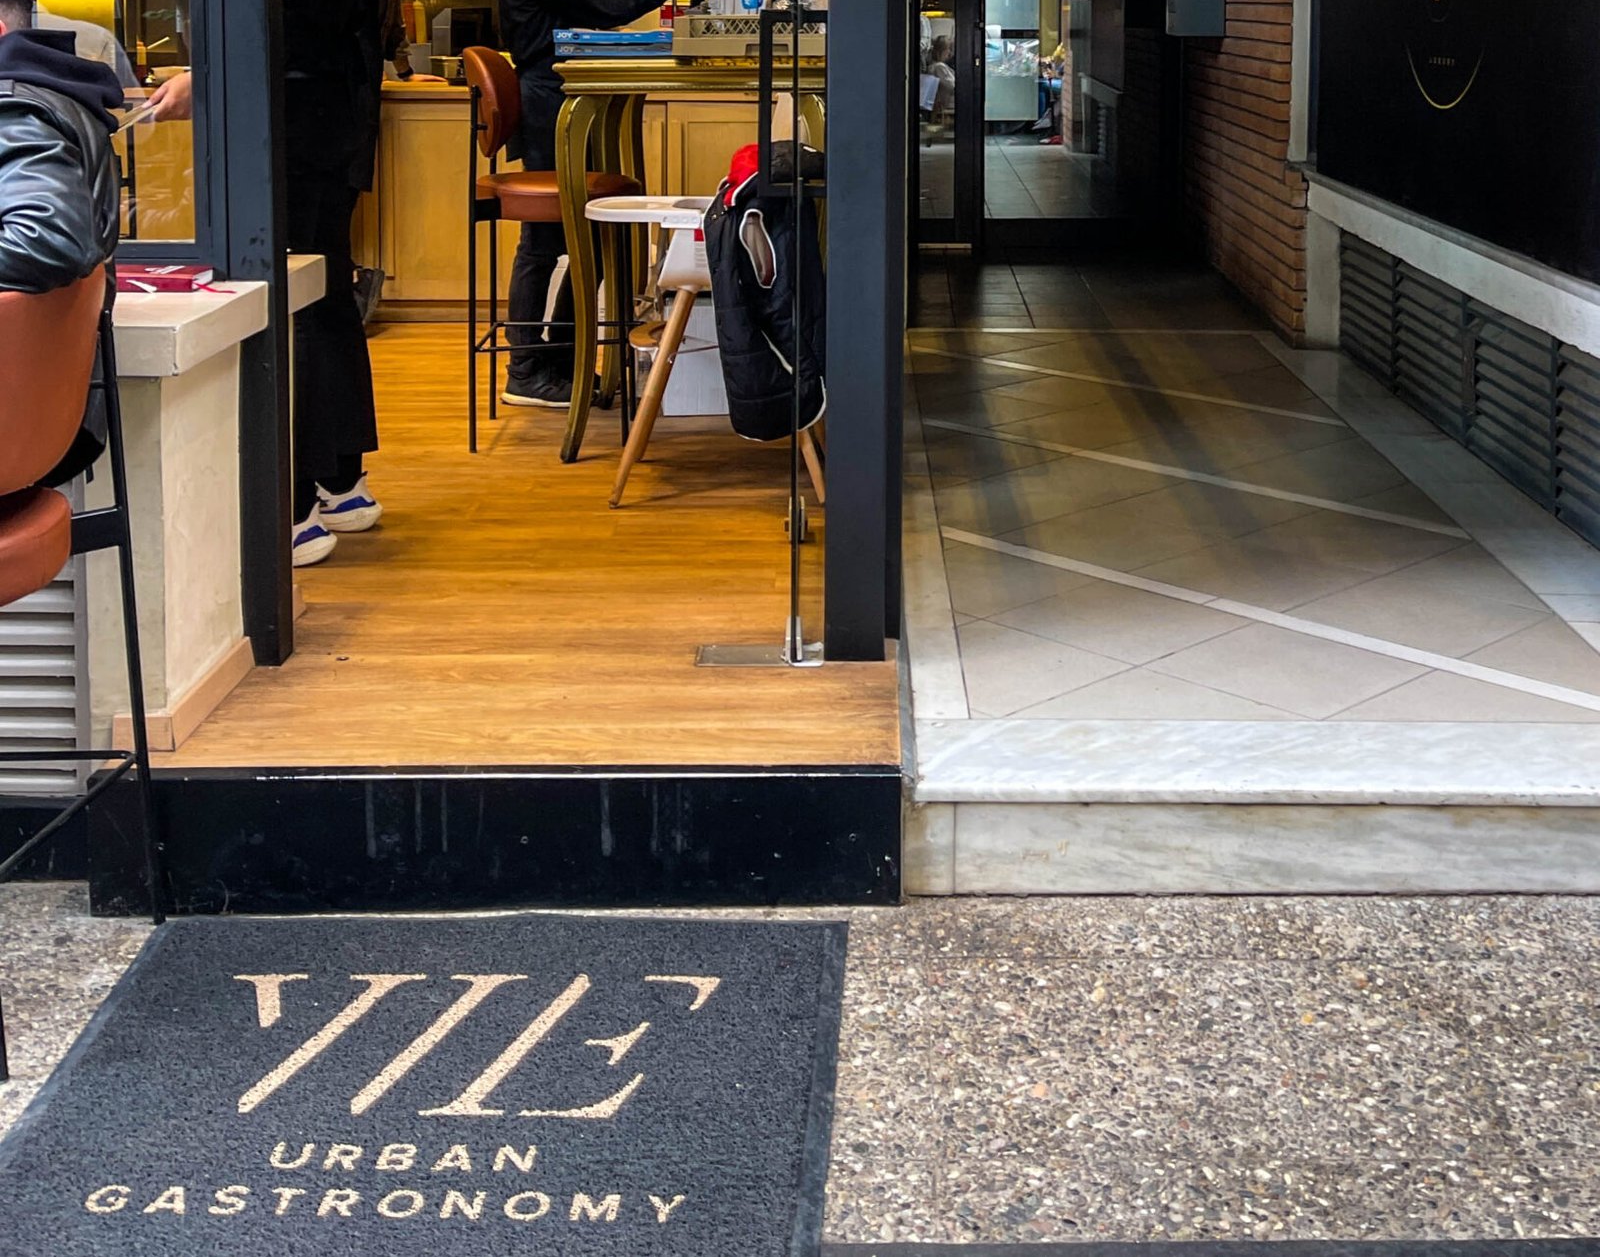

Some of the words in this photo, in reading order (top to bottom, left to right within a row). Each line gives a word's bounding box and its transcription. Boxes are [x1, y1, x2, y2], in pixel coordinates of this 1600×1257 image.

[556, 31, 573, 39] JOY
[232, 973, 722, 1119] VIE
[268, 1141, 537, 1173] URBAN
[84, 1184, 686, 1224] GASTRONOMY
